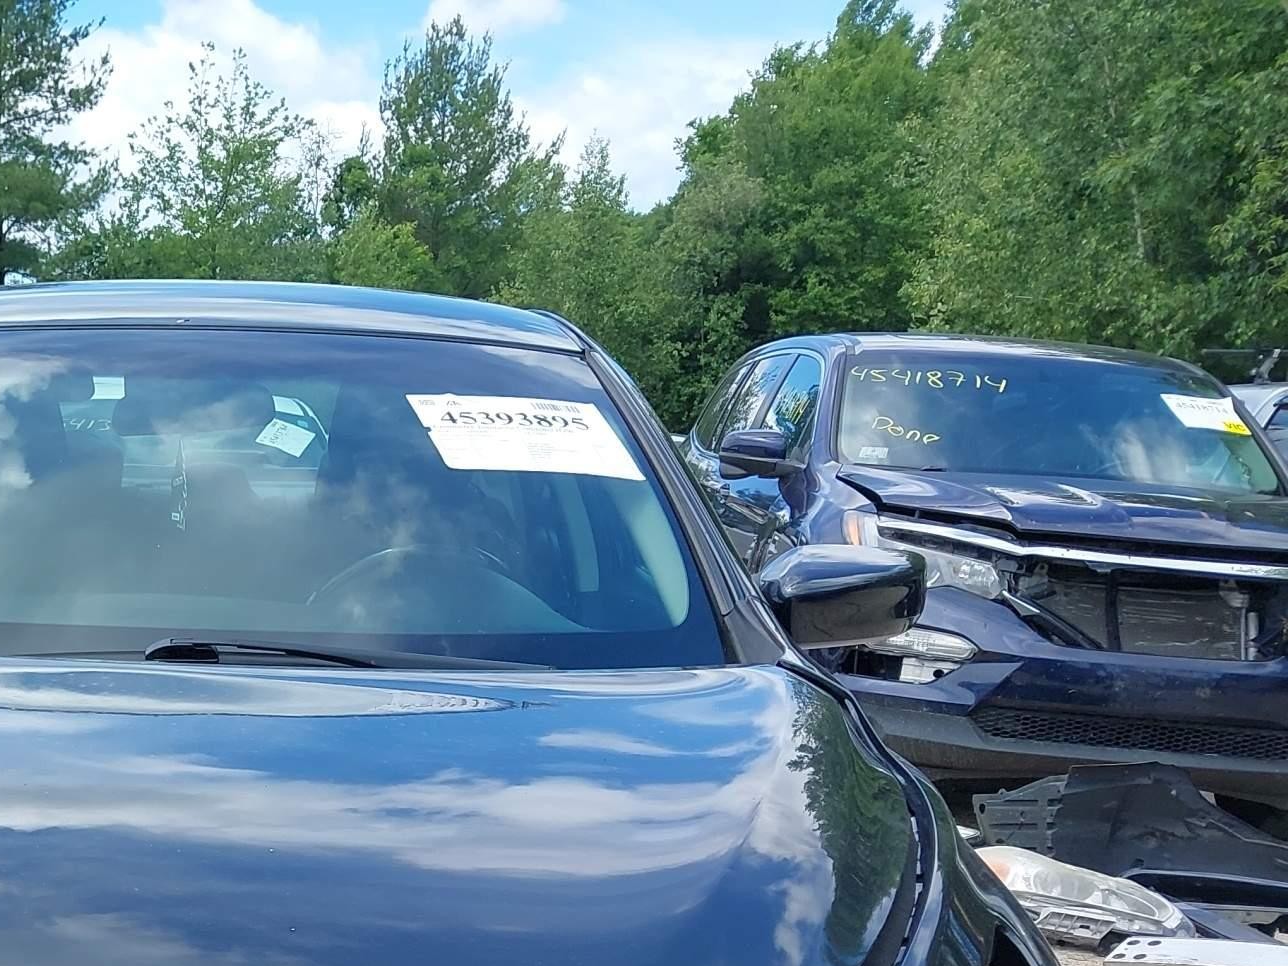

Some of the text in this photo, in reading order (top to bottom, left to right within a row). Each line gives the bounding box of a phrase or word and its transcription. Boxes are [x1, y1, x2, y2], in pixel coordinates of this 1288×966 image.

[851, 366, 1007, 393] 45418714
[440, 410, 589, 431] 45393895
[871, 416, 941, 445] Done
